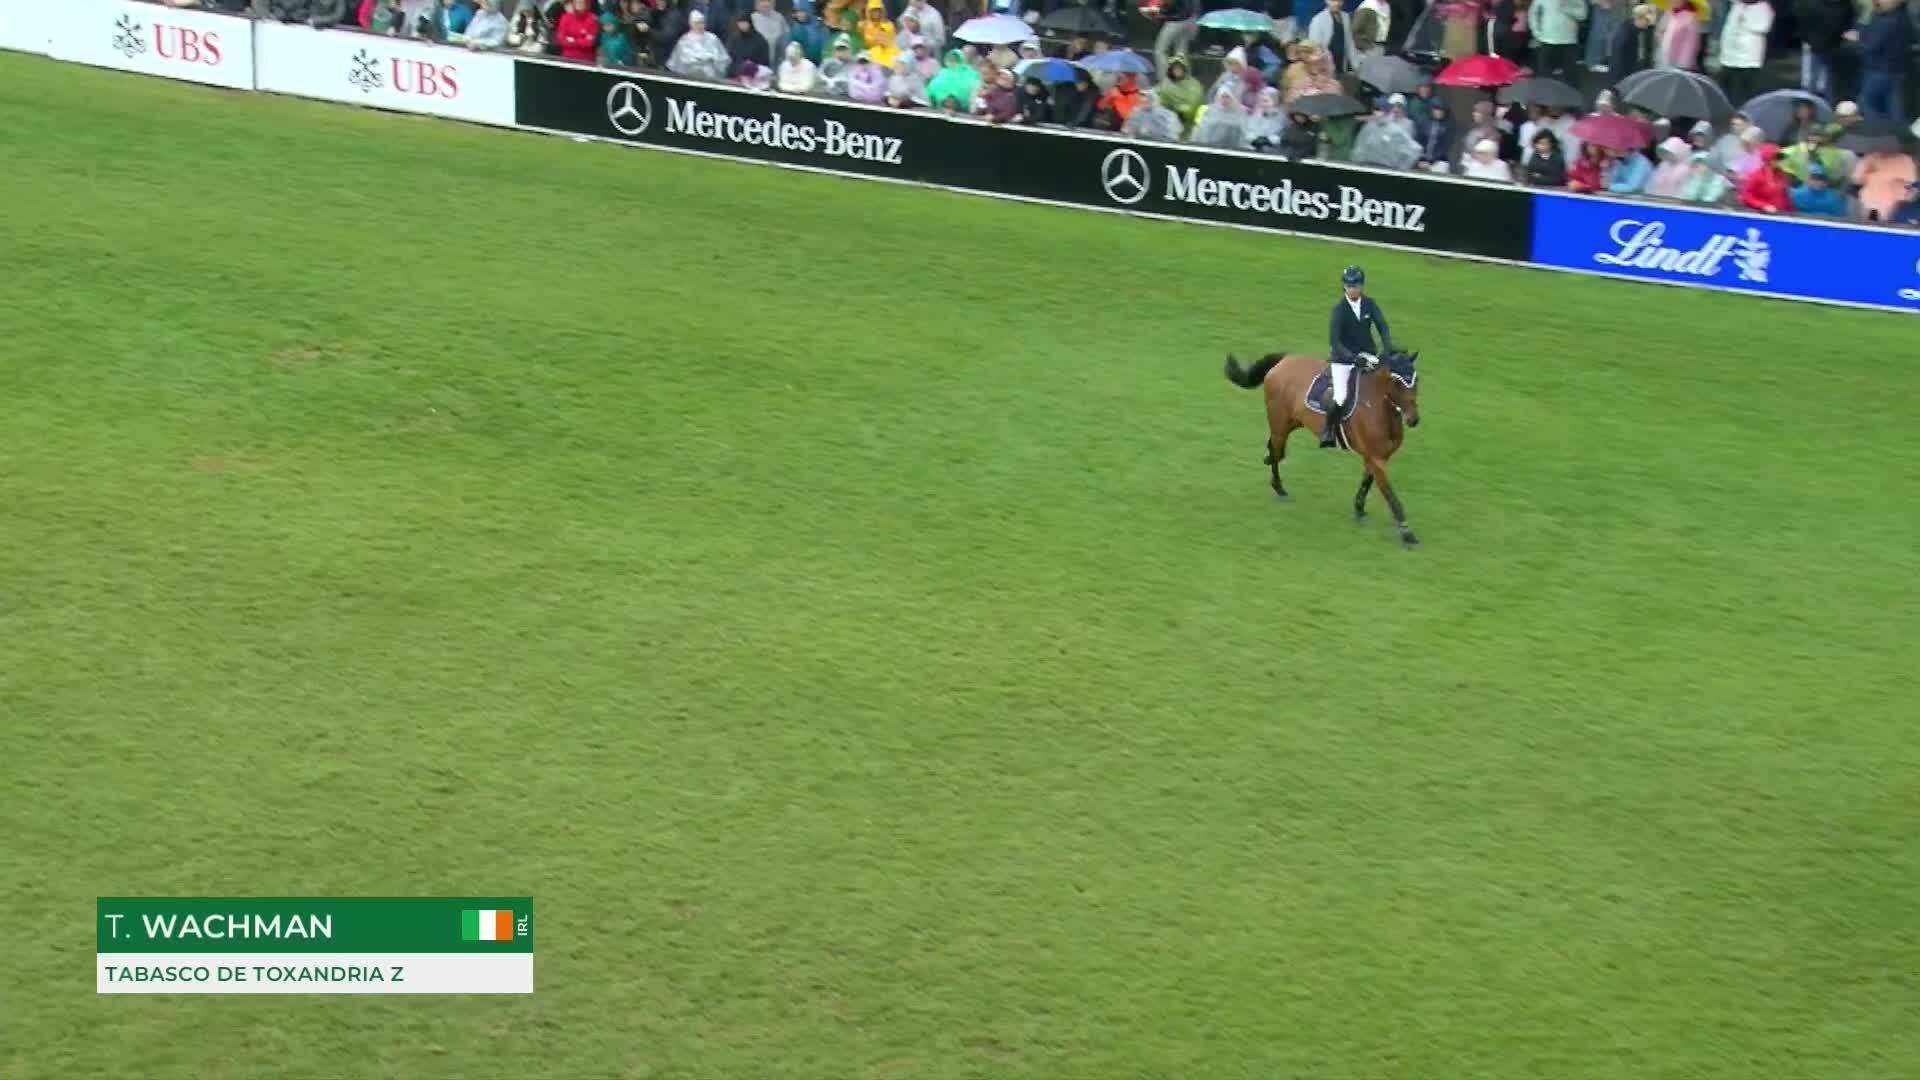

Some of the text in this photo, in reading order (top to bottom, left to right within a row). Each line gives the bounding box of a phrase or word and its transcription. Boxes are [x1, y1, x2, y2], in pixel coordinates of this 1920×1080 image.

[152, 23, 222, 66] UBS
[391, 56, 459, 99] UBS
[665, 98, 904, 165] Mercedes-Benz
[1164, 165, 1426, 233] Mercedes-Benz
[1593, 218, 1738, 277] Lindt
